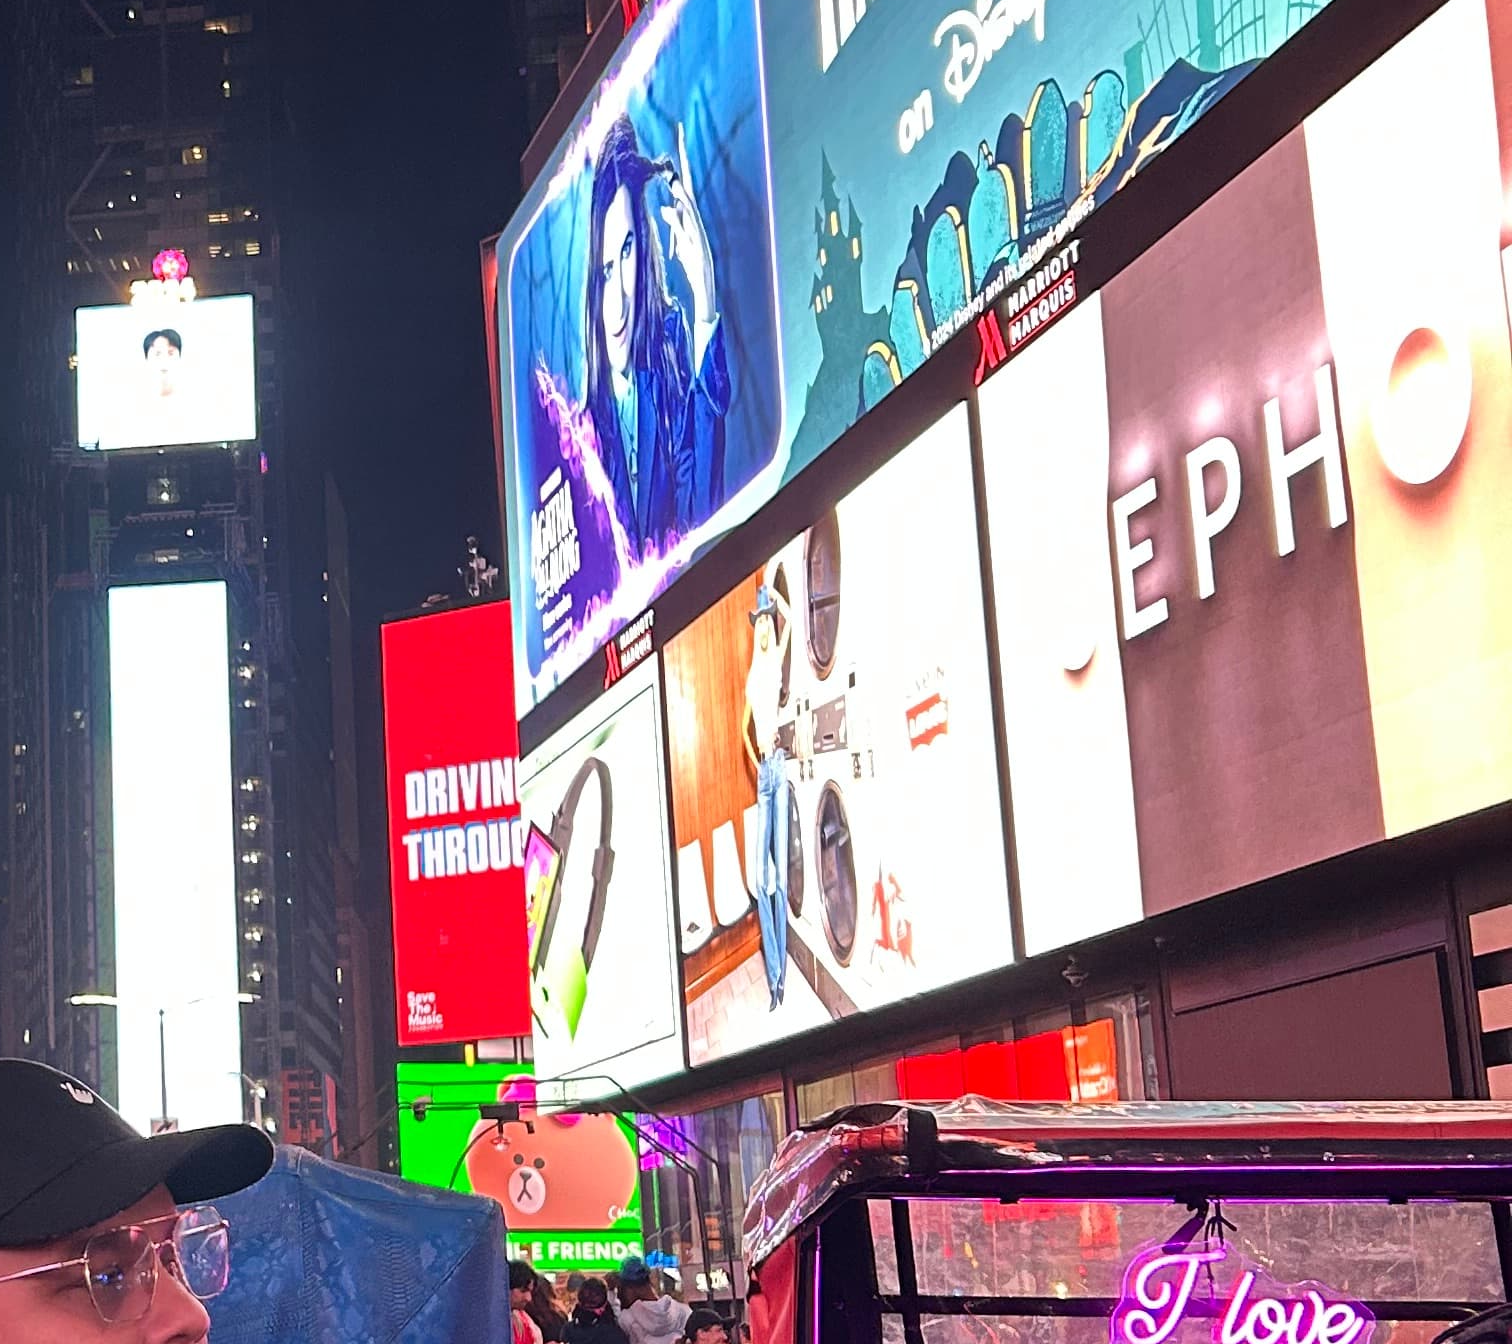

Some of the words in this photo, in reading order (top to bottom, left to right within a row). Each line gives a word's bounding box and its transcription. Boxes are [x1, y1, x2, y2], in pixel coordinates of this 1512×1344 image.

[898, 87, 935, 155] on
[1008, 239, 1081, 318] MARRIOTT
[1010, 276, 1075, 346] MARQUIS
[404, 755, 522, 820] DRIVIN
[407, 990, 437, 1005] Save
[408, 1002, 432, 1015] The
[407, 1013, 443, 1026] Music
[548, 1241, 645, 1262] FRIENDS
